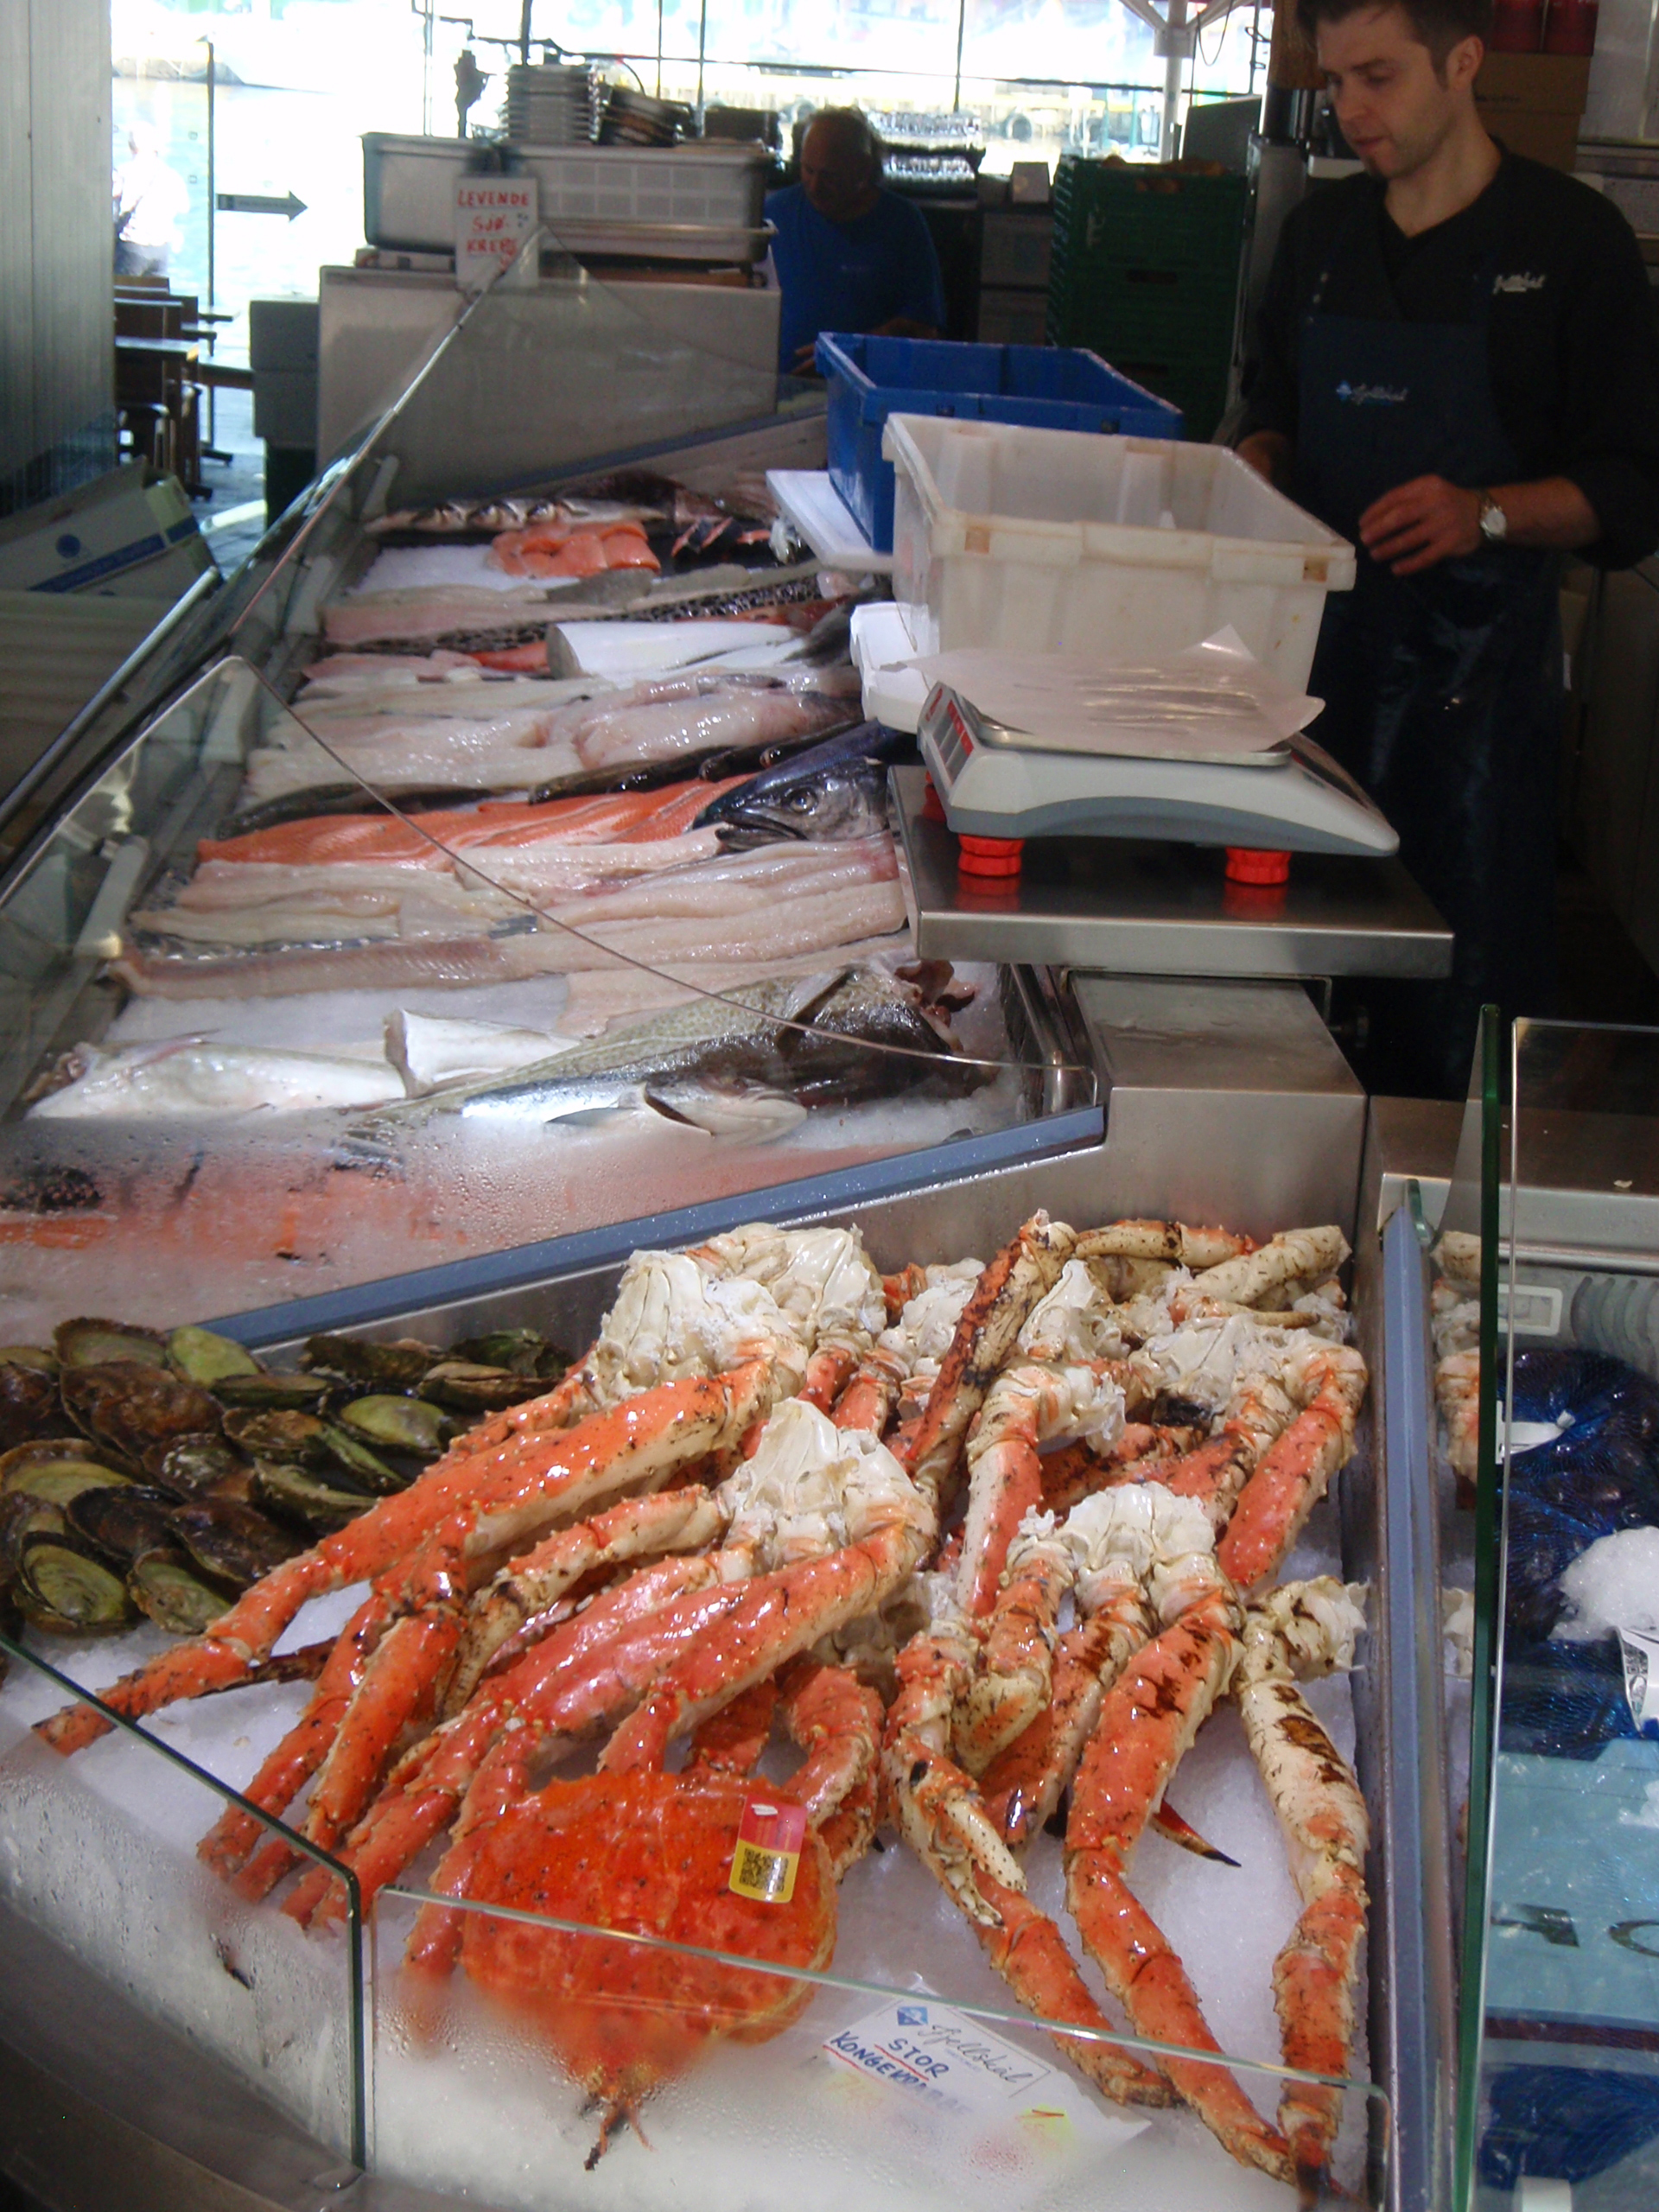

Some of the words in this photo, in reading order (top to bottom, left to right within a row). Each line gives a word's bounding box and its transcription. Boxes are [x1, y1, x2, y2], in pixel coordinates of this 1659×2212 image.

[458, 189, 529, 207] LEVENDE
[830, 2031, 974, 2113] KONGEKR
[888, 2038, 950, 2078] STOR
